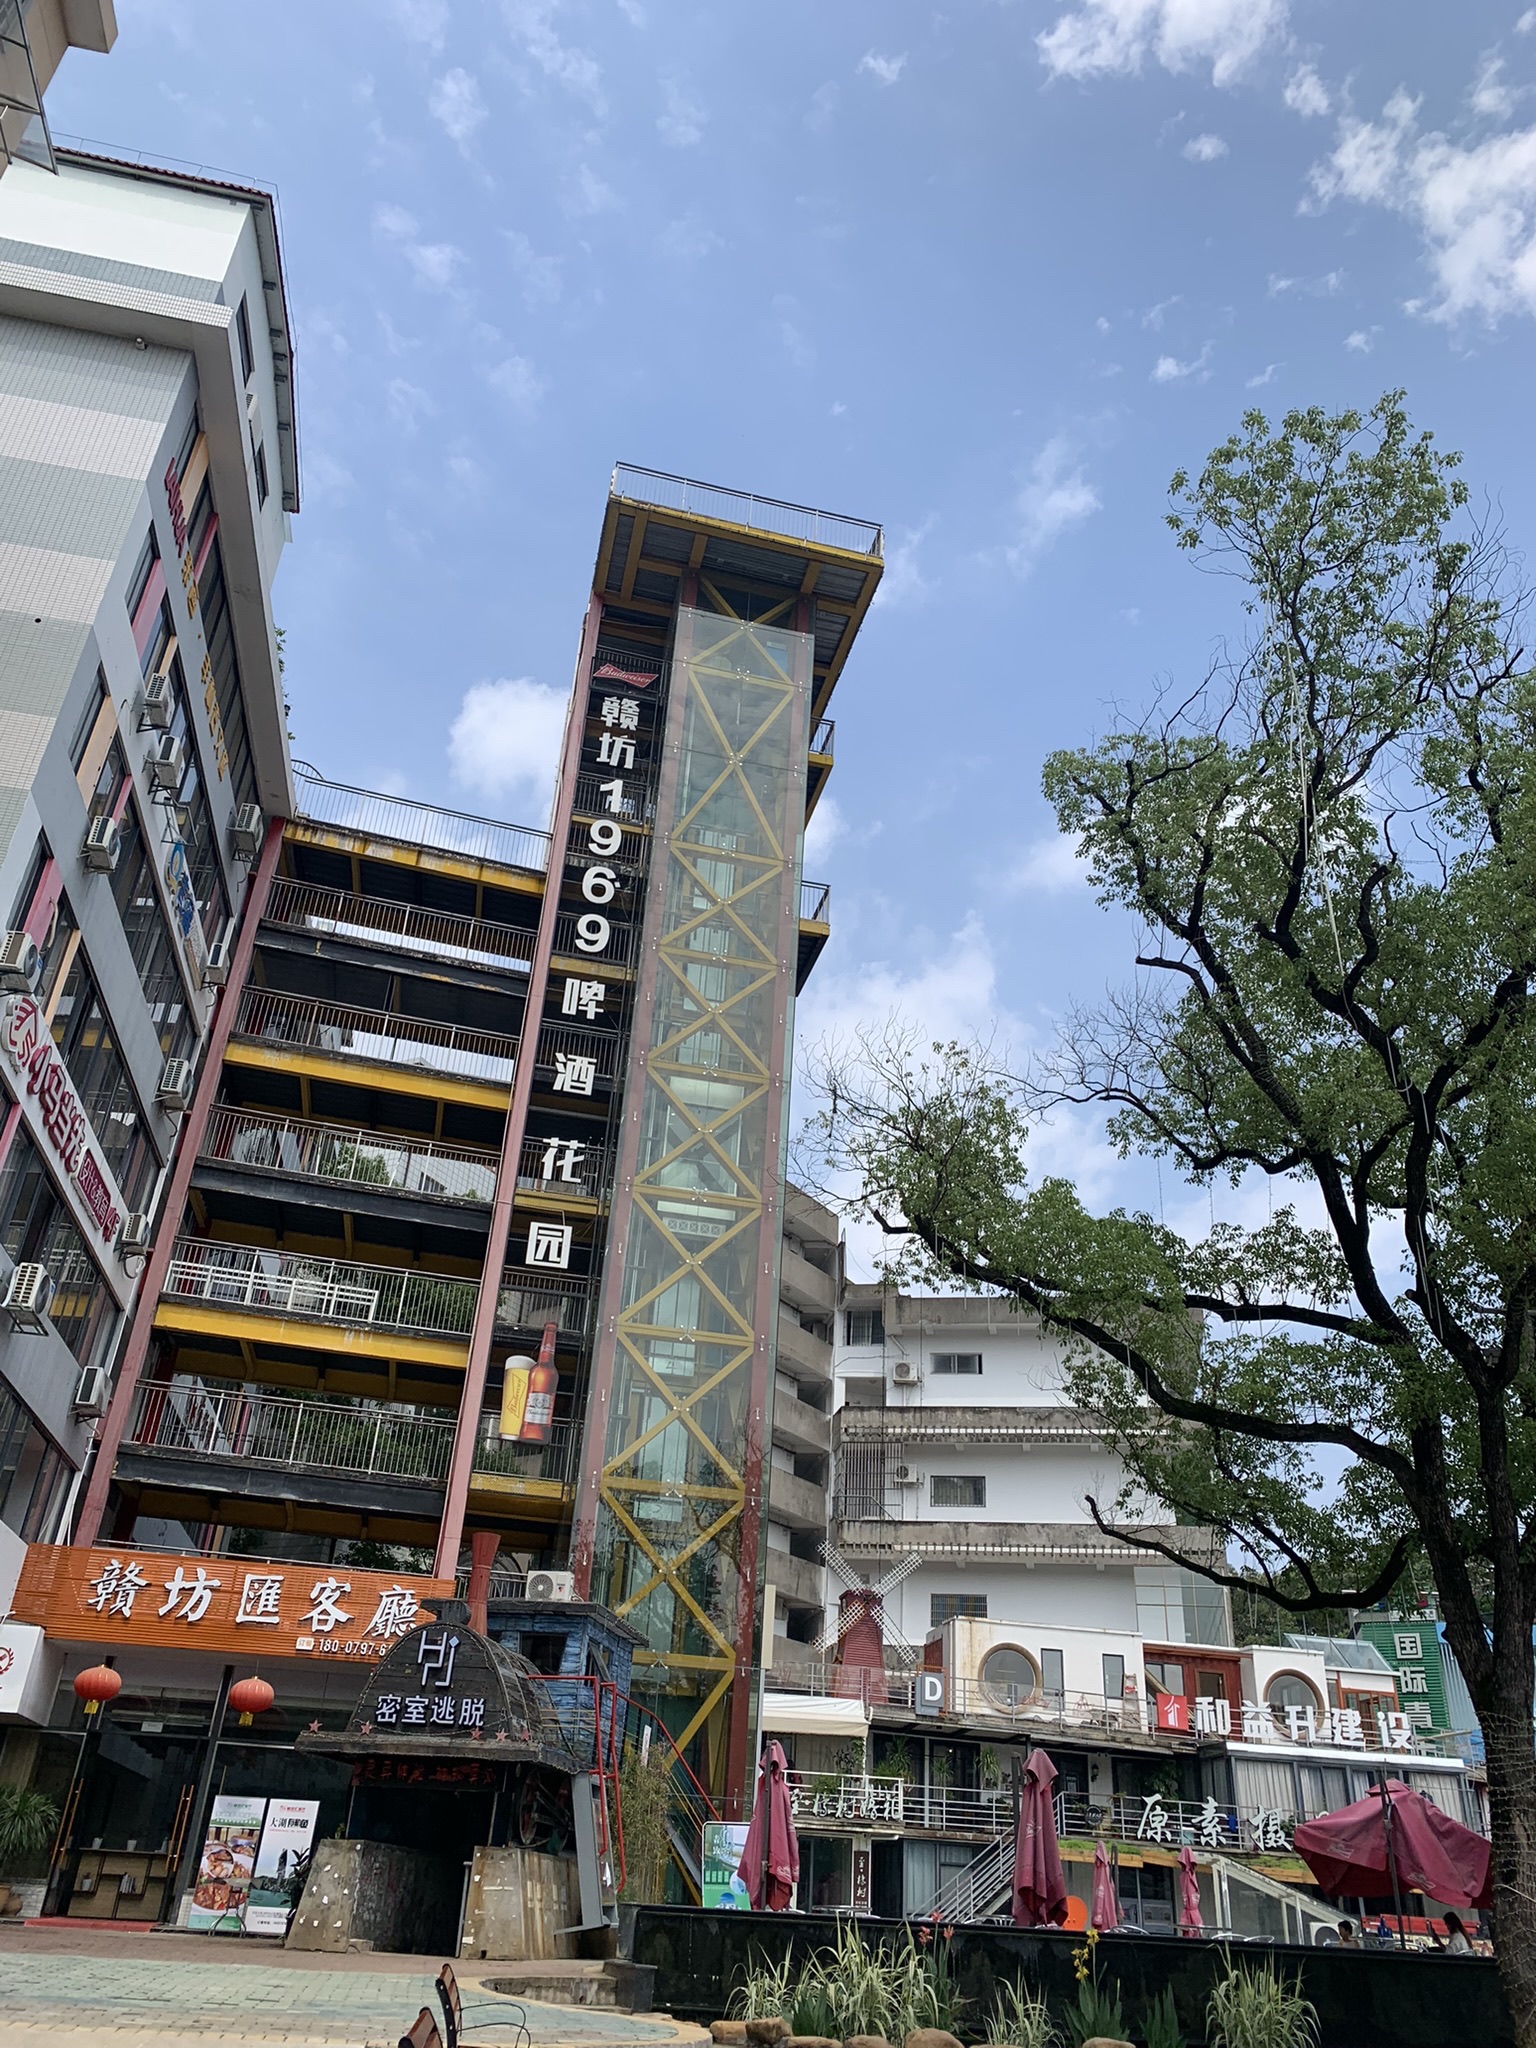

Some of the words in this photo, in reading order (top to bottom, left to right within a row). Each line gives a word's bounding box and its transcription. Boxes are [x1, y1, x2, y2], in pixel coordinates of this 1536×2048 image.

[375, 1693, 485, 1727] 密室逃脱
[925, 1676, 942, 1701] D
[1195, 1696, 1415, 1750] 和益升建设
[1137, 1793, 1329, 1851] 原素摄
